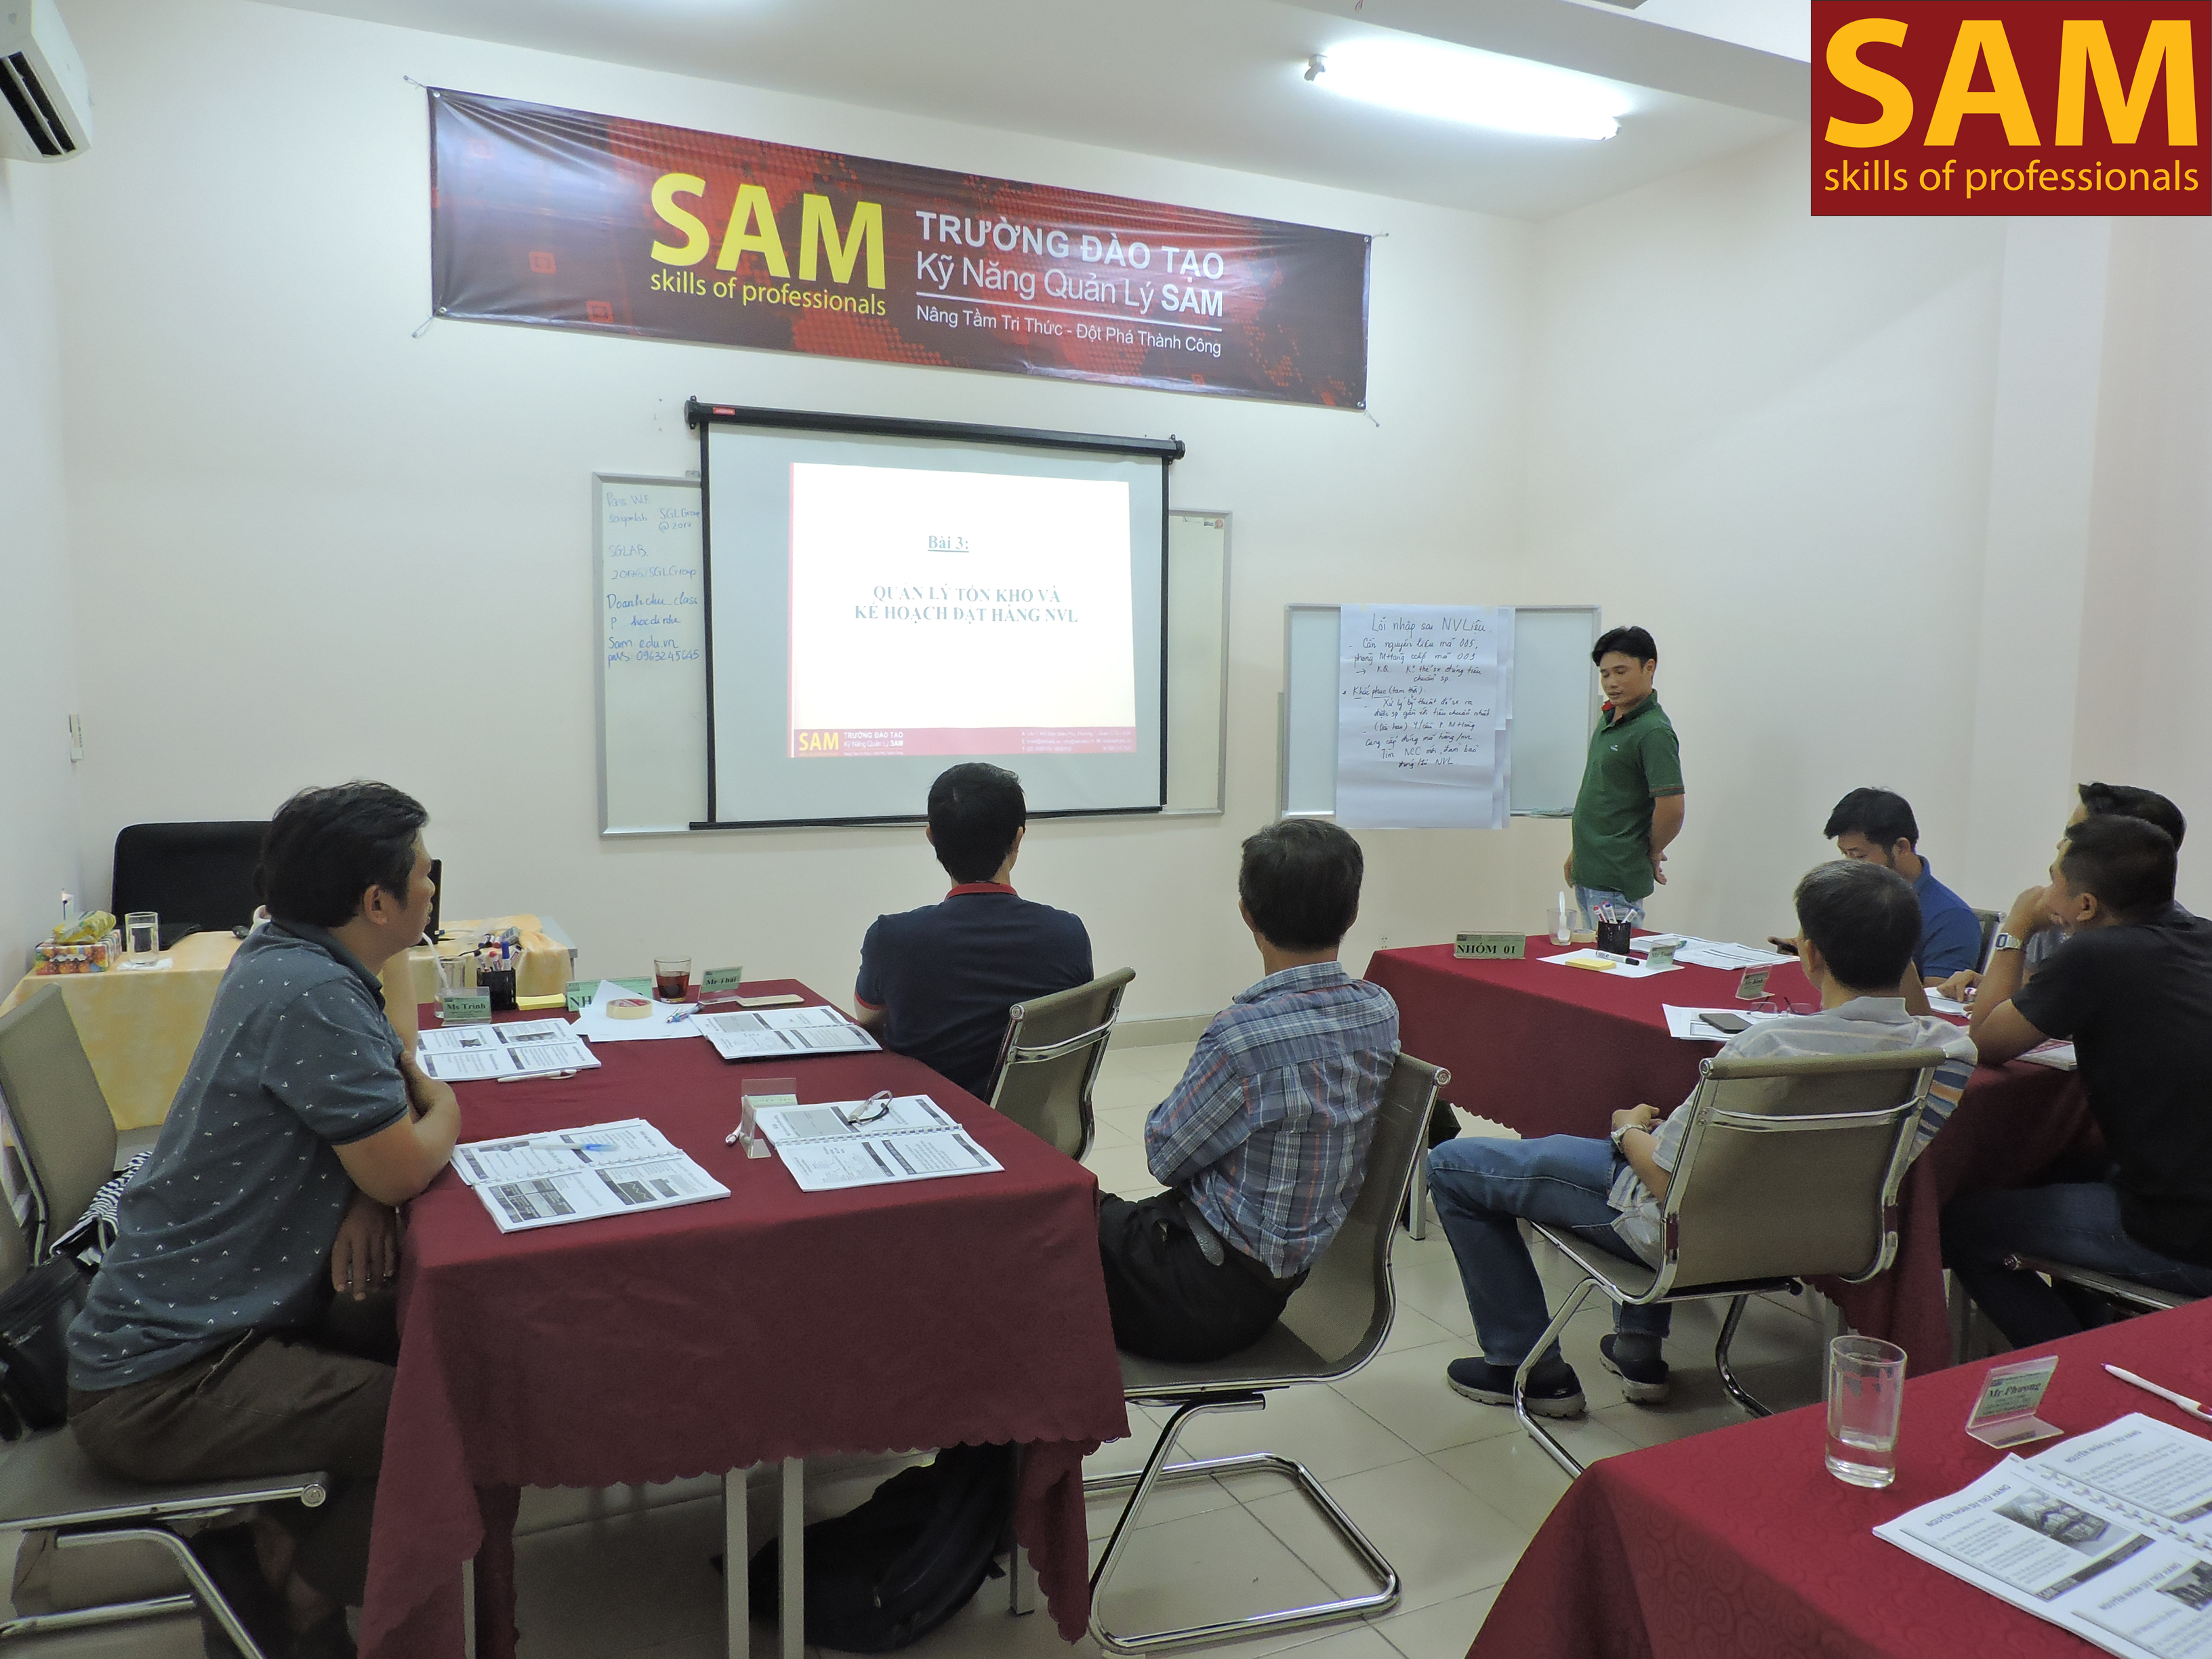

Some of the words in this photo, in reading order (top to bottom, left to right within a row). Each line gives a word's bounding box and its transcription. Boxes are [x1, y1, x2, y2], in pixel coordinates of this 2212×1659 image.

[651, 173, 886, 289] SAM
[916, 211, 1069, 258] TRƯỜNG
[1080, 232, 1151, 269] ĐÀO
[1162, 245, 1225, 283] TẠO
[651, 270, 706, 295] skills
[713, 276, 736, 298] of
[742, 283, 886, 315] professionals
[917, 251, 951, 290] Kỹ
[963, 257, 1036, 301] Năng
[1044, 268, 1115, 304] Quản
[1124, 279, 1154, 314] Lý
[1161, 284, 1223, 317] SAM
[917, 305, 958, 327] Nâng
[963, 308, 996, 329] Tầm
[1025, 316, 1063, 337] Thức
[1076, 324, 1101, 344] Đột
[1106, 326, 1134, 345] Phá
[1138, 331, 1181, 350] Thành
[1185, 337, 1221, 357] Công
[928, 535, 951, 549] Bài
[956, 537, 968, 550] 3:
[929, 583, 950, 600] LÝ
[996, 588, 1033, 602] KHO
[1038, 586, 1061, 602] VÀ
[855, 601, 879, 619] KẾ
[884, 606, 947, 623] HOẠCH
[991, 605, 1041, 622] HÀNG
[1046, 608, 1078, 622] NVL
[799, 732, 839, 750] SAM
[1457, 943, 1496, 954] NHÓM
[1504, 945, 1515, 954] 01
[570, 996, 592, 1008] NH
